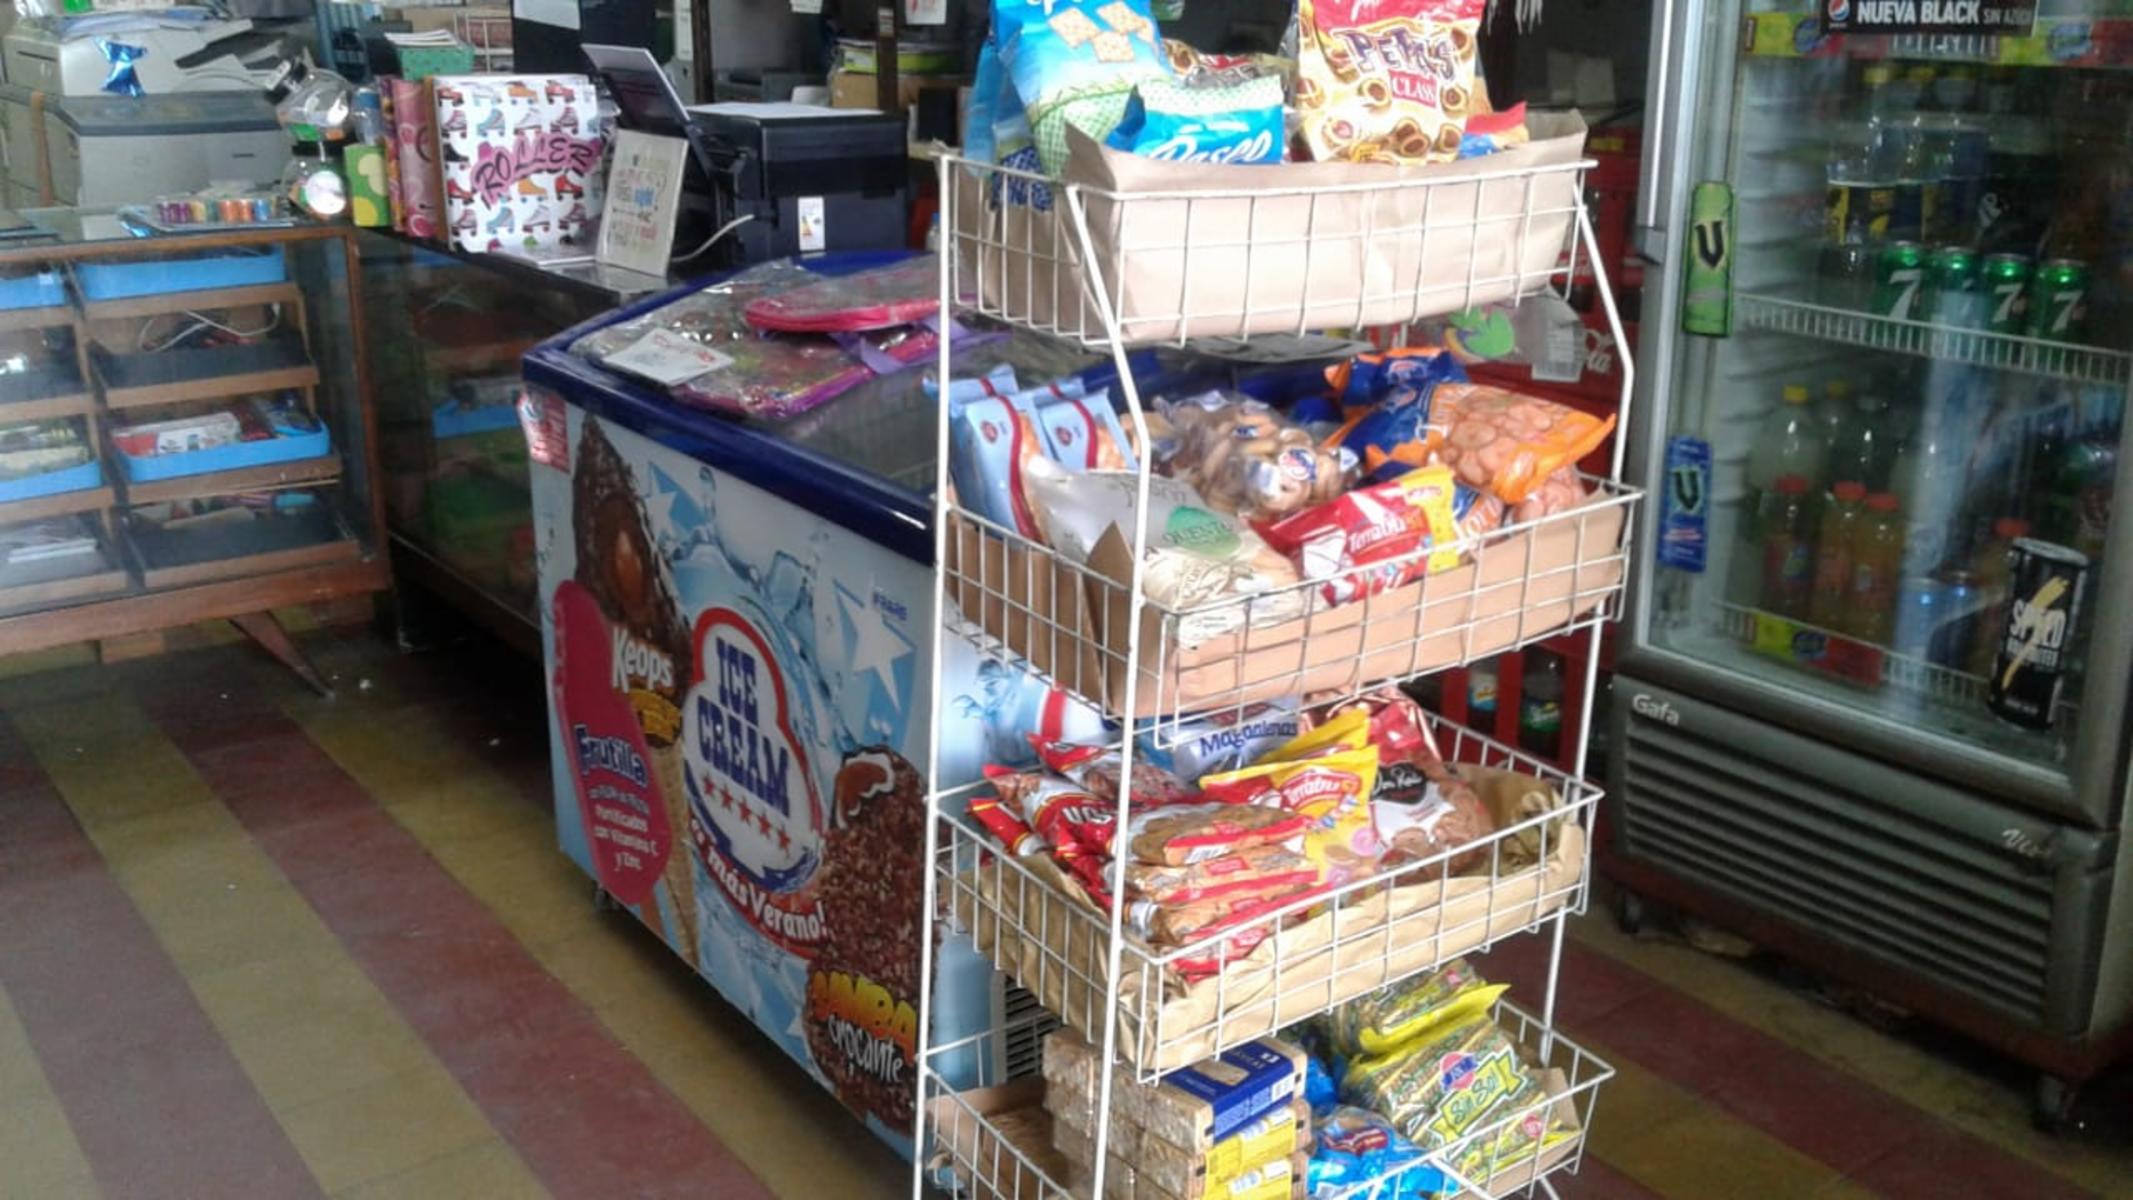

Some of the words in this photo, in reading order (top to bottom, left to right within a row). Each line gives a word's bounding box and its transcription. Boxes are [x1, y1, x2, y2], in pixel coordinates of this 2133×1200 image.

[1856, 0, 1916, 24] NUEVA
[1920, 1, 1980, 24] BLACK
[474, 137, 595, 209] ROLLER
[612, 626, 674, 694] Keops
[716, 636, 759, 728] ICE
[1632, 694, 1679, 726] Gafa
[574, 723, 650, 788] Frutilla
[697, 694, 791, 820] CREAM
[1284, 773, 1361, 806] Terrabu
[706, 846, 748, 907] más
[747, 881, 828, 941] Verano!
[827, 1014, 903, 1083] crocante
